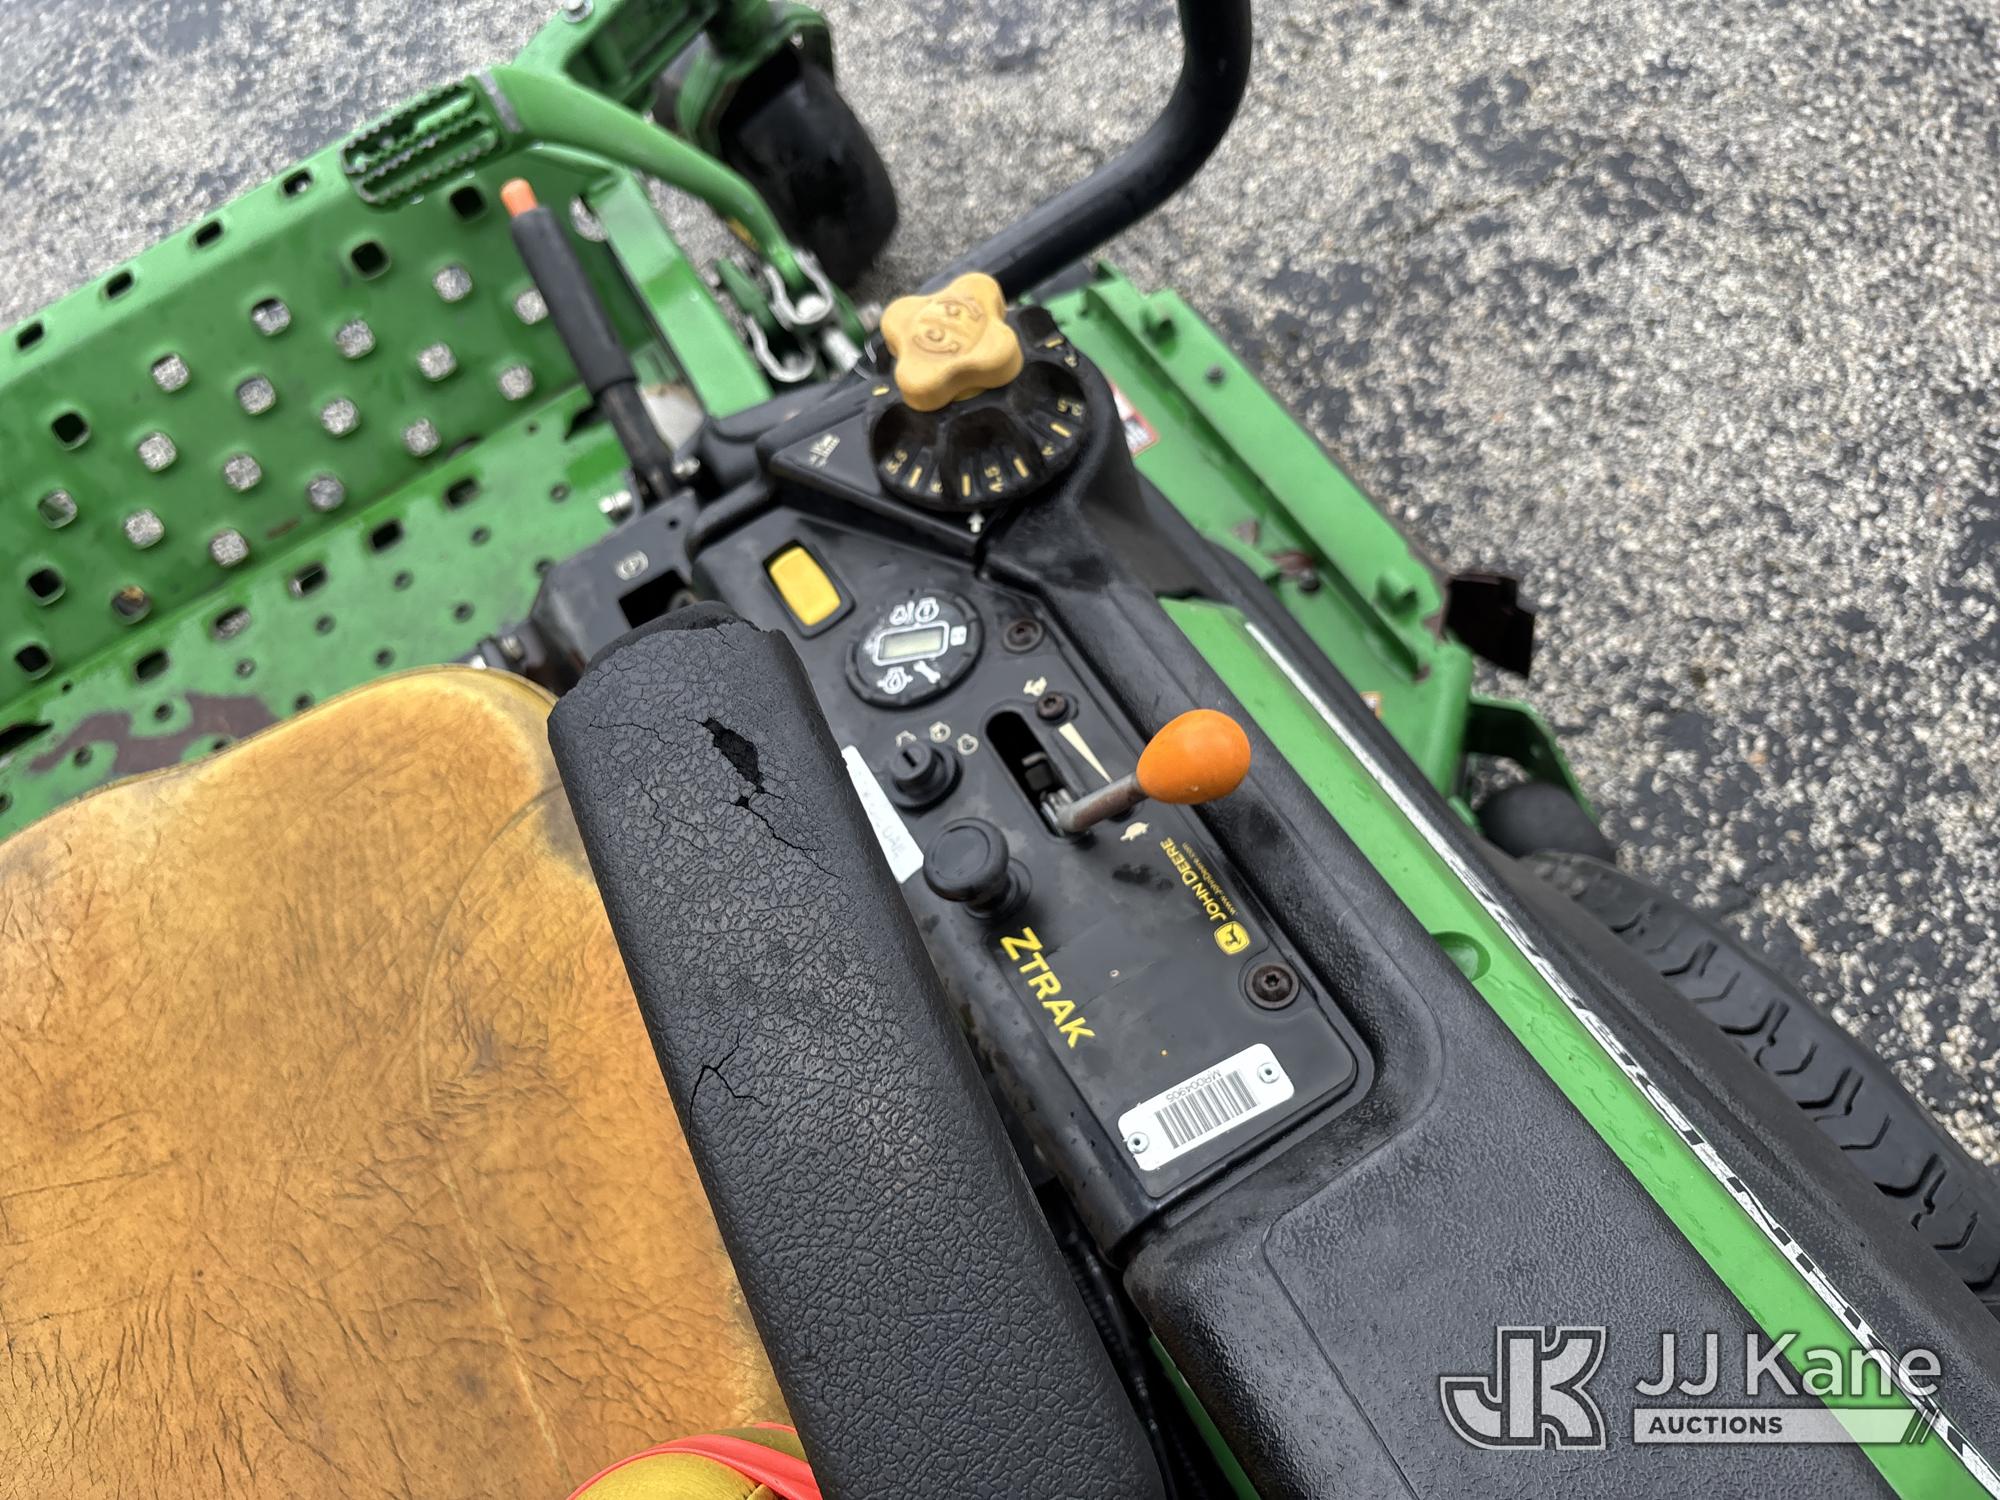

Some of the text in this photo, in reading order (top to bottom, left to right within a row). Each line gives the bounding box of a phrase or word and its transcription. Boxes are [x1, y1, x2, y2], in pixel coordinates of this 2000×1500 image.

[1159, 836, 1227, 921] JOHN DEERE
[1000, 926, 1096, 1049] ZTRAK
[1166, 1069, 1222, 1103] MR004905
